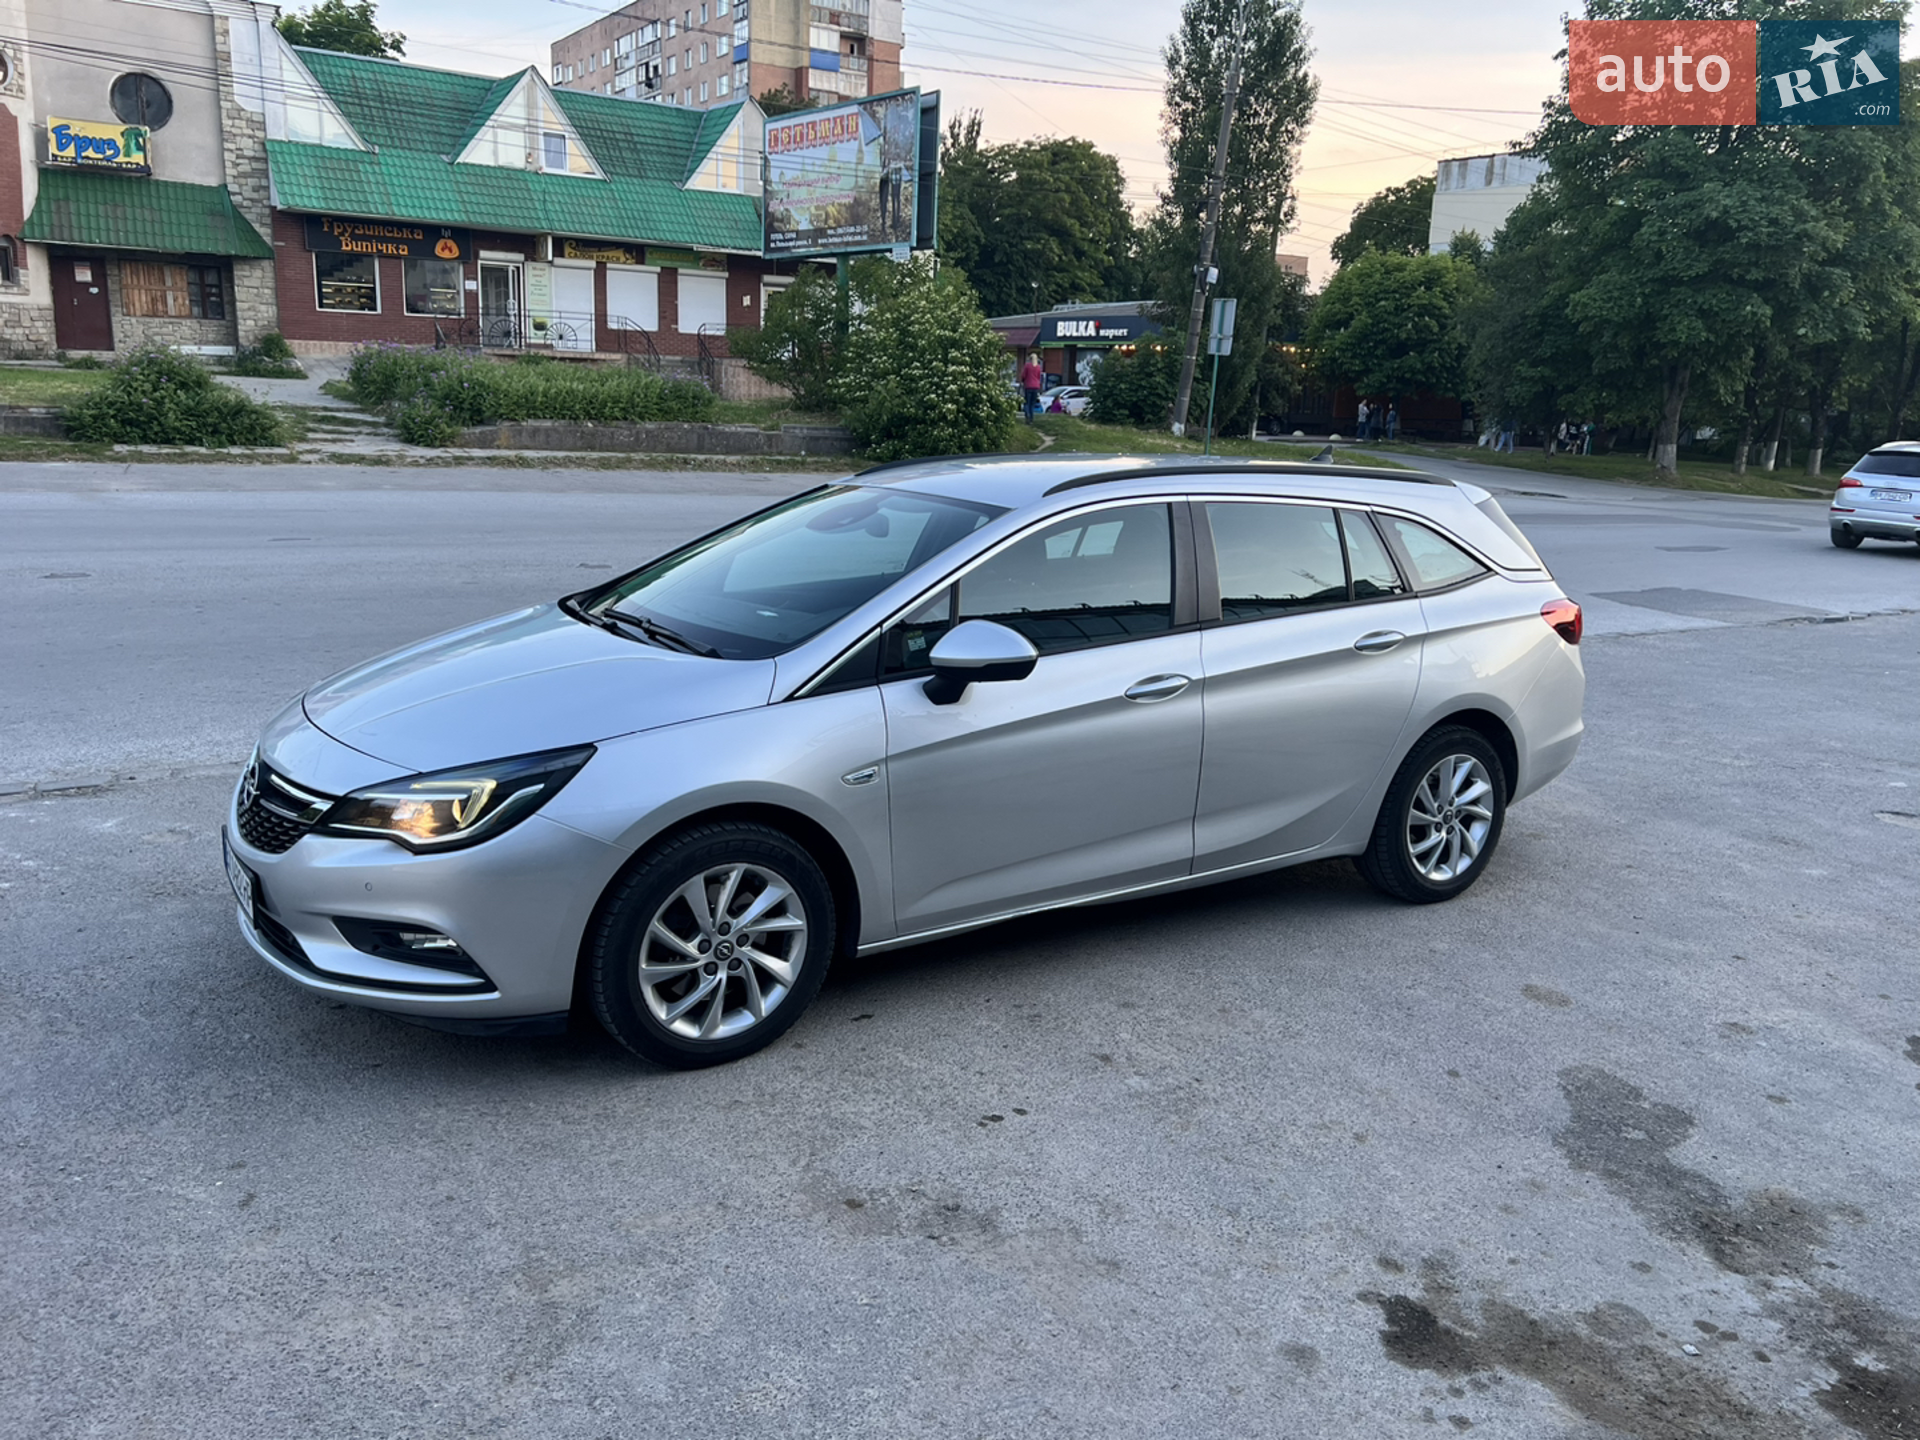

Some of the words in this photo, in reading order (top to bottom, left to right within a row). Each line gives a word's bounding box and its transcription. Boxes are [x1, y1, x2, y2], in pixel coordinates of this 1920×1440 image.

[51, 124, 121, 162] Бриз
[321, 217, 424, 240] Грузинська
[339, 236, 409, 256] Випічка
[1056, 321, 1097, 337] BULKA
